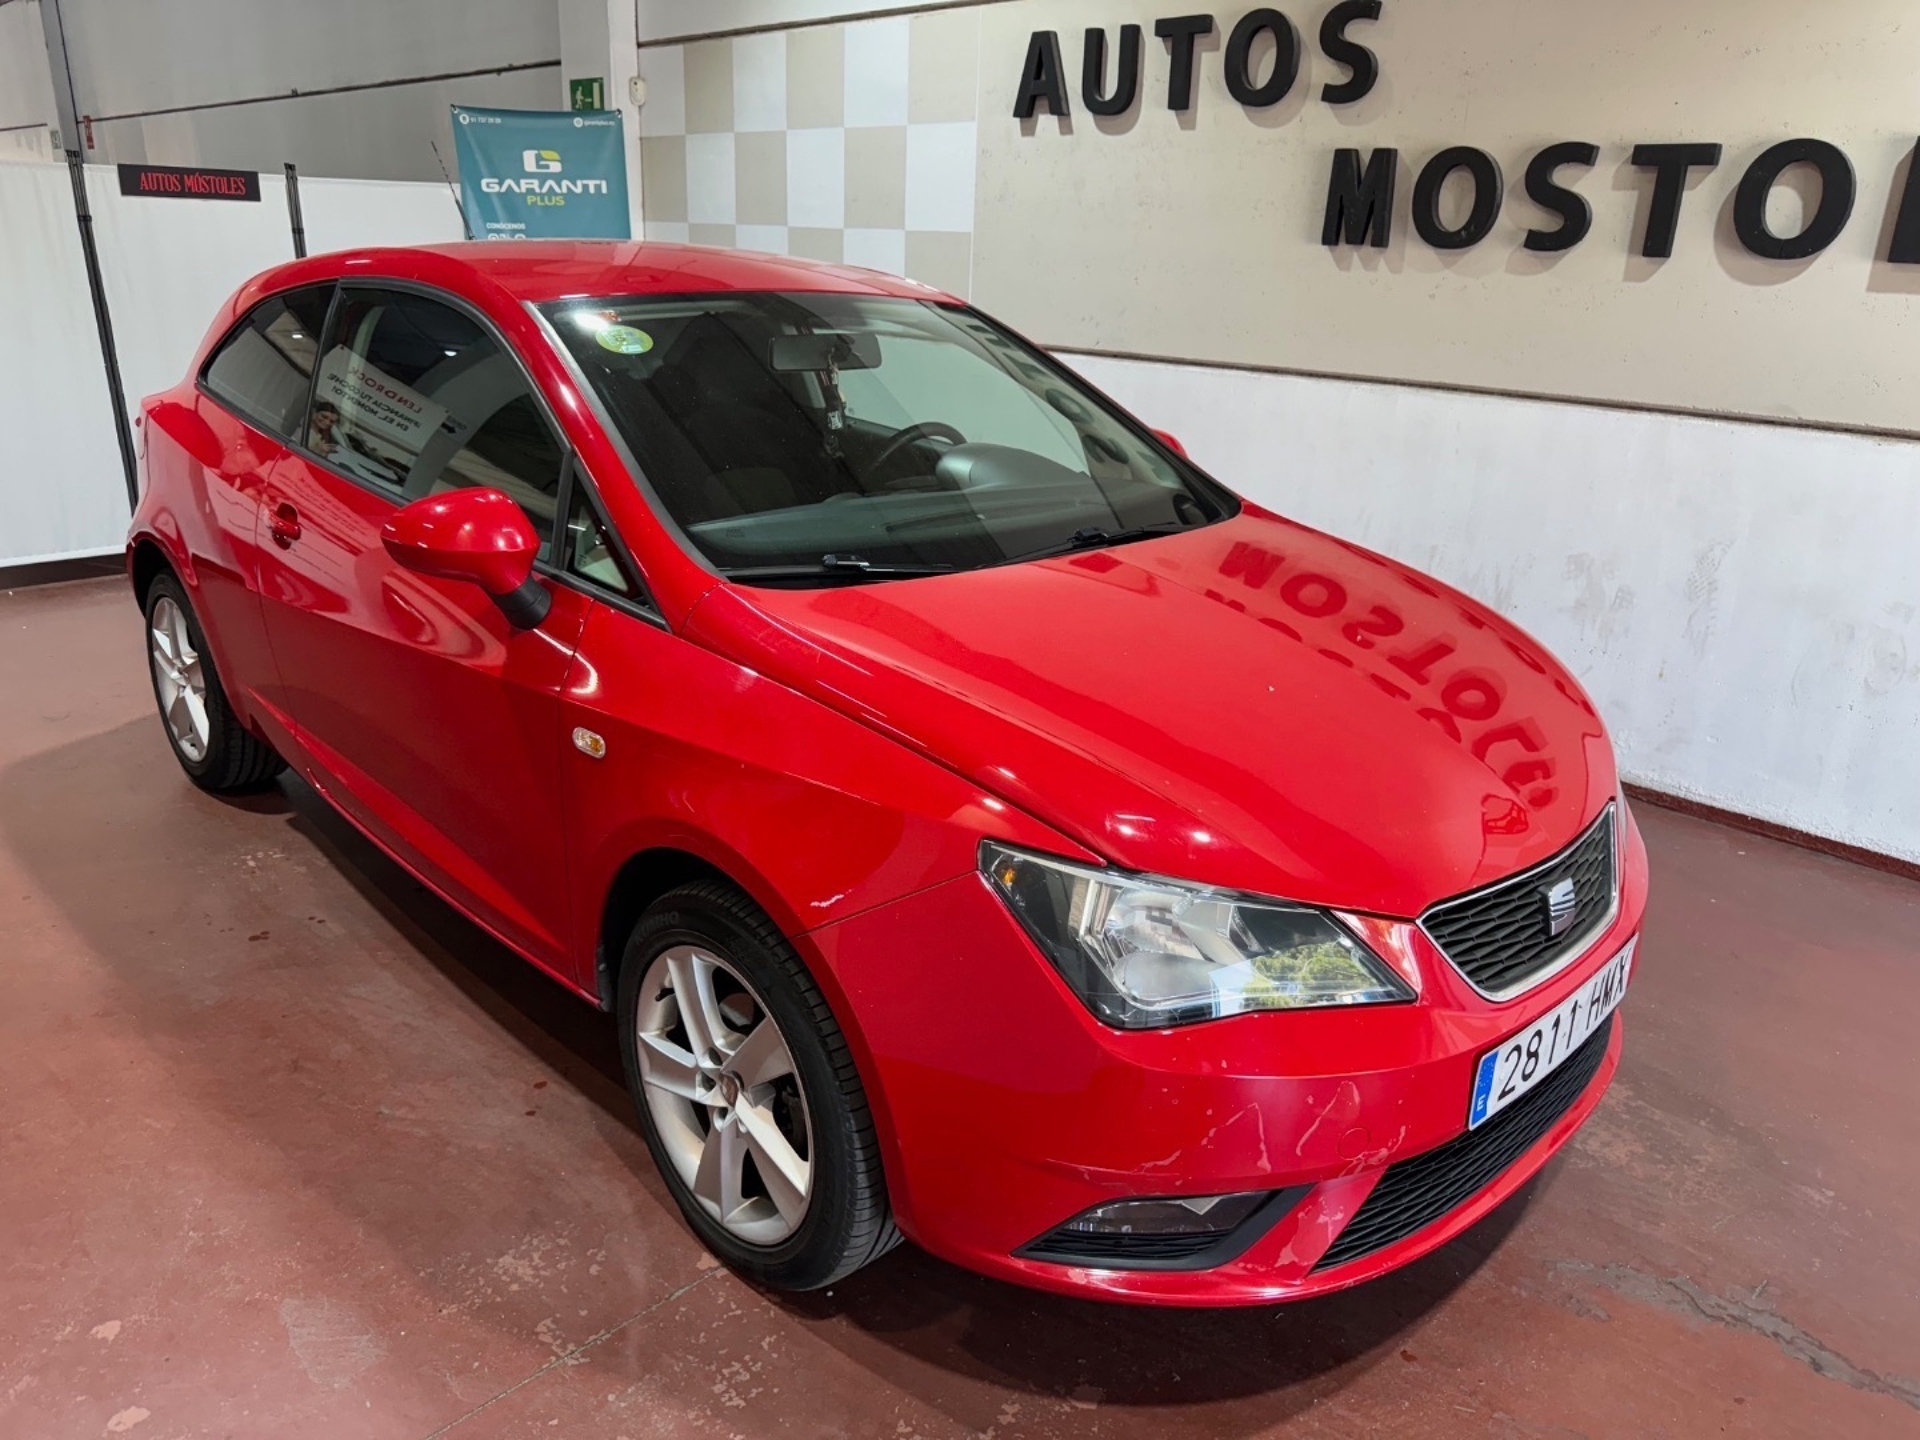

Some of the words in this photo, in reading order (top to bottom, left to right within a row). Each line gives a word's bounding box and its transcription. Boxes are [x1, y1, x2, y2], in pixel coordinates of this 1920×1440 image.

[1013, 0, 1382, 118] AUTOS
[140, 172, 181, 192] AUTOS
[184, 172, 246, 195] MÓSTOLES
[481, 178, 607, 194] GARANTI
[527, 195, 565, 206] PLUS
[1497, 1000, 1579, 1102] 2811
[1476, 1093, 1487, 1112] E
